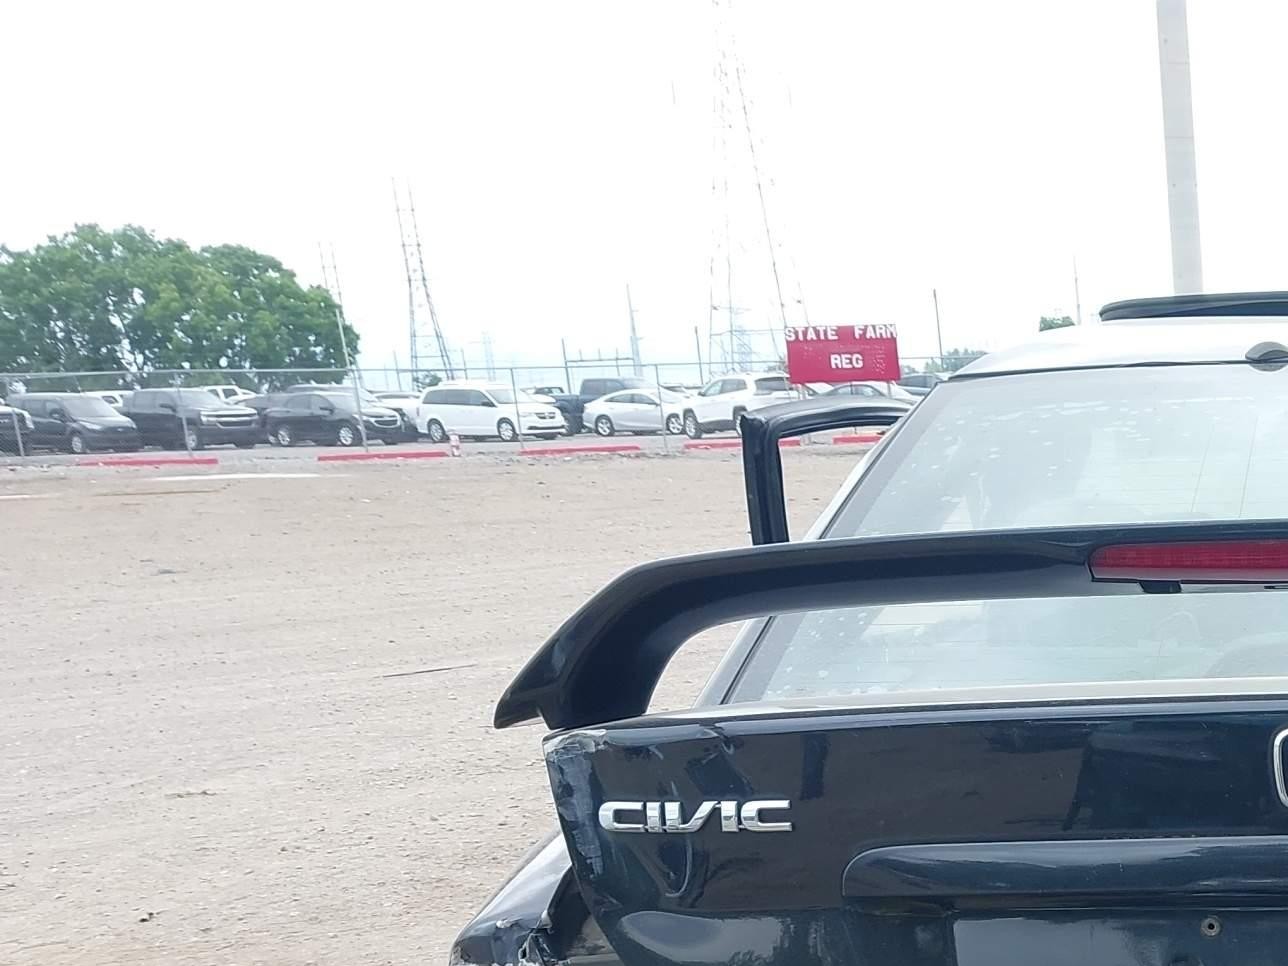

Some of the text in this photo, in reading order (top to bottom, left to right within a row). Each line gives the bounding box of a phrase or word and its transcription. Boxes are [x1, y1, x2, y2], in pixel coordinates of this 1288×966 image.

[785, 326, 838, 341] STATE
[830, 353, 863, 369] REG
[598, 799, 793, 833] CIVIC
